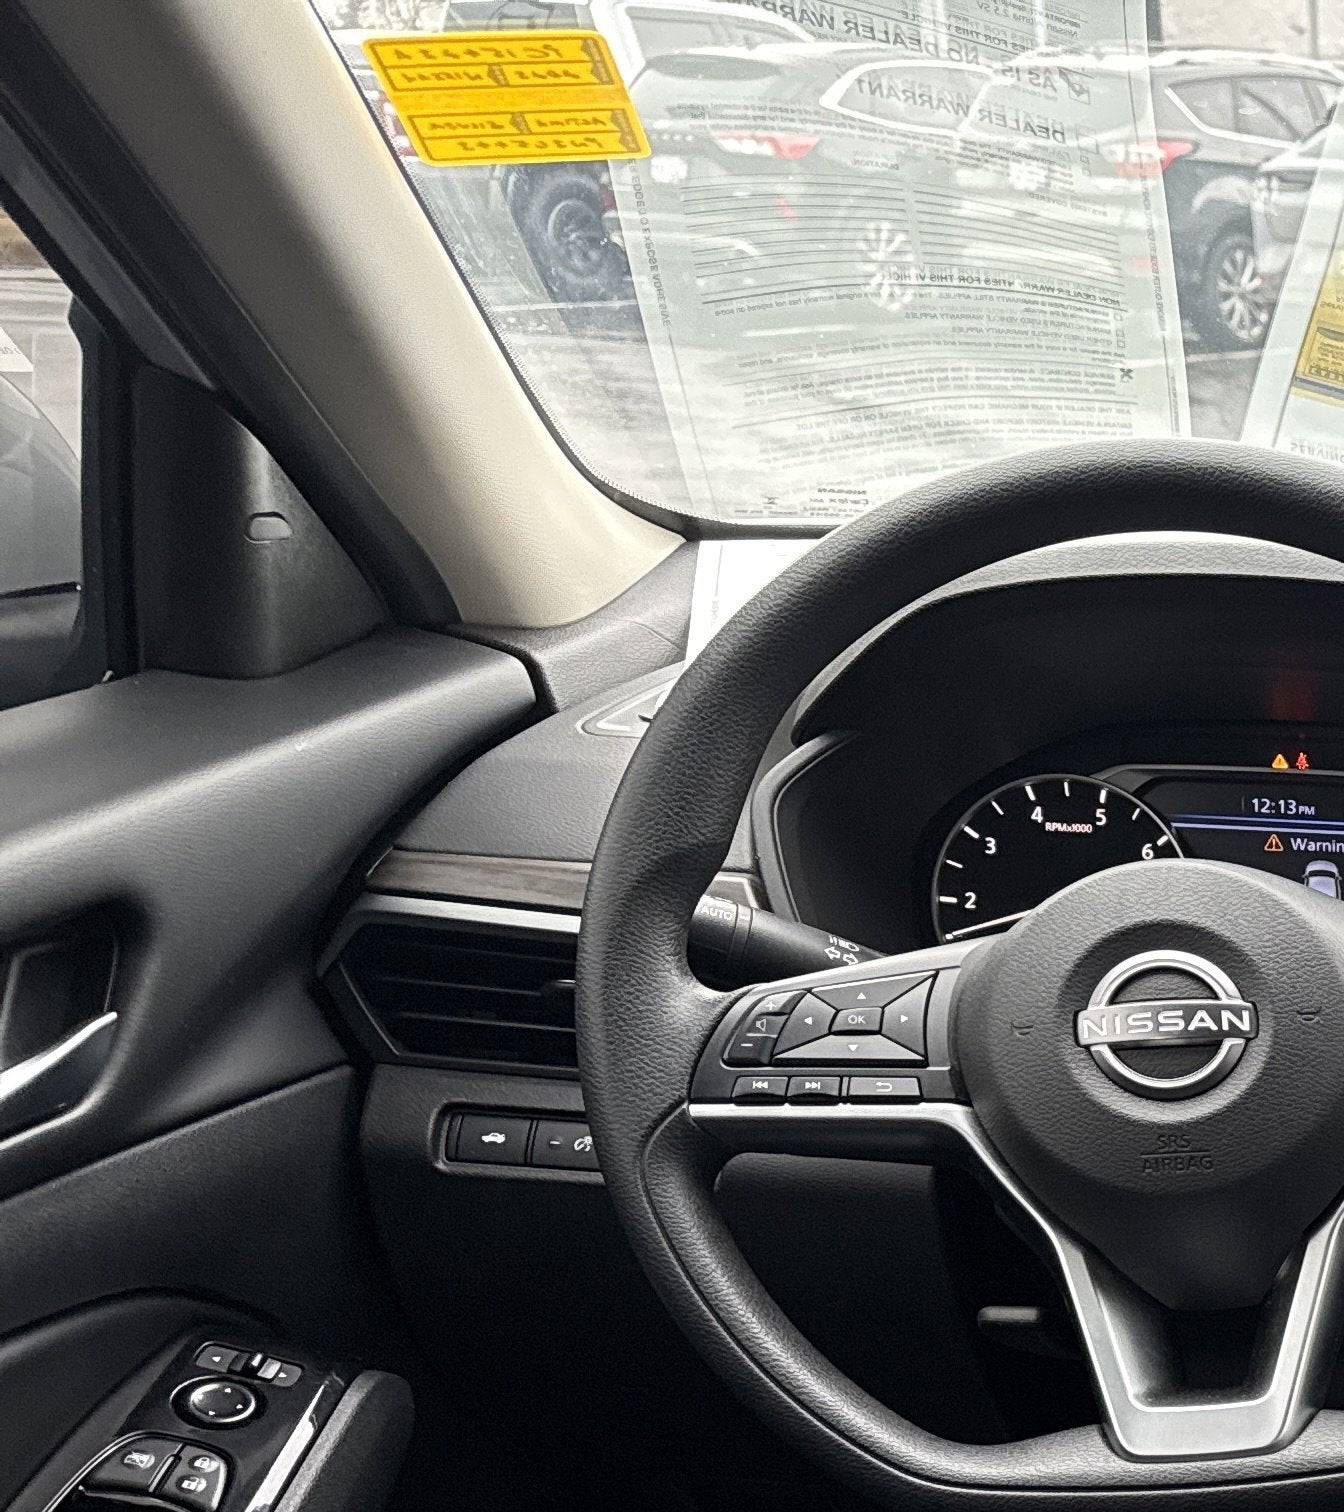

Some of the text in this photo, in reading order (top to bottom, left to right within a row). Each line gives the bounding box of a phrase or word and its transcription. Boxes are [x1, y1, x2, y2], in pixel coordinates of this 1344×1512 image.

[1031, 806, 1044, 823] 4
[1252, 798, 1297, 815] 12:13
[1095, 808, 1107, 826] 5
[984, 836, 997, 854] 3
[1140, 843, 1154, 860] 6
[964, 891, 977, 909] 2
[699, 904, 733, 921] AUTO
[846, 1014, 867, 1026] OK
[1081, 1007, 1253, 1041] NISSAN
[1156, 1133, 1191, 1150] SRS
[1140, 1154, 1214, 1173] AIRBAG
